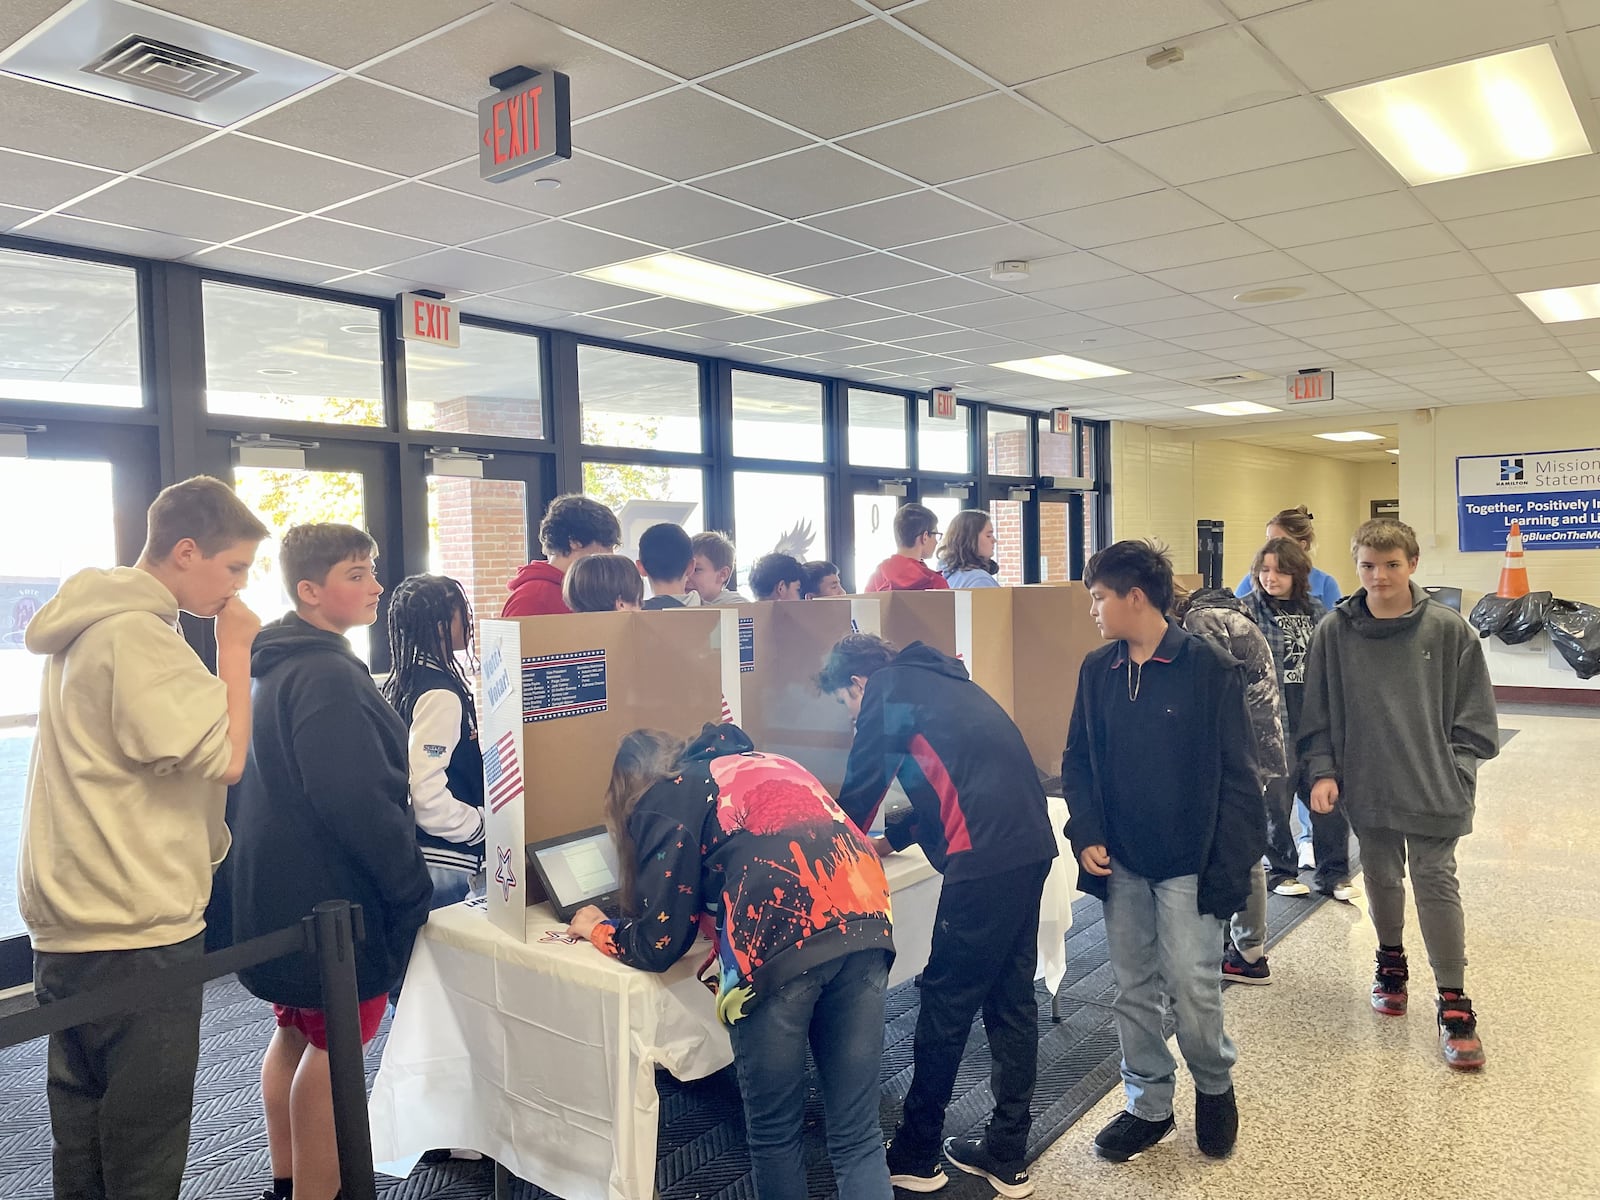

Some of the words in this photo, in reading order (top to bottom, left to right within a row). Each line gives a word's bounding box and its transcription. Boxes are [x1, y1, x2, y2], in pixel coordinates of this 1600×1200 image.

[492, 85, 543, 165] EXIT
[414, 300, 451, 341] EXIT
[1294, 375, 1324, 400] EXIT
[937, 393, 954, 416] EXIT
[1057, 412, 1070, 433] EXIT
[1536, 459, 1600, 473] Mission
[1466, 502, 1524, 515] Together,
[1527, 498, 1589, 511] Positively
[1504, 514, 1559, 527] Learning
[1562, 513, 1587, 524] and
